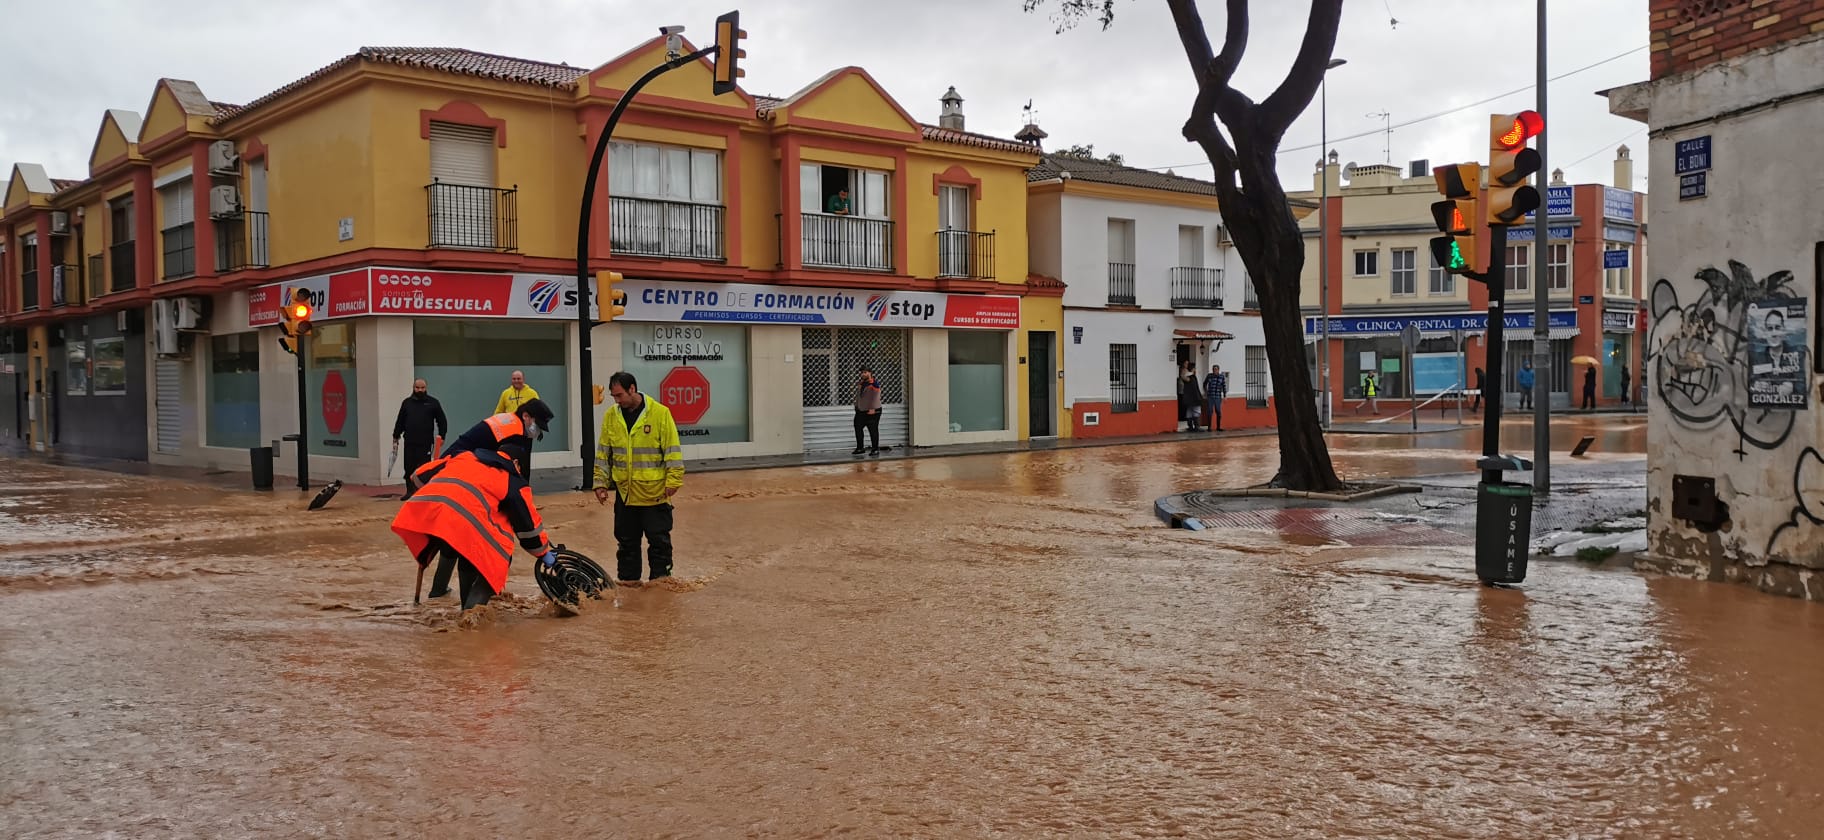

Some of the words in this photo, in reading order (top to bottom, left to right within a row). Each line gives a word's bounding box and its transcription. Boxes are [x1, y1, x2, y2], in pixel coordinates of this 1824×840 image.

[1682, 140, 1704, 152] CALLE
[1678, 158, 1686, 170] EL
[335, 298, 366, 312] FORMACIÓN
[380, 297, 493, 311] AUTOESCUELA
[642, 289, 719, 306] CENTRO
[726, 291, 748, 307] DE
[754, 291, 855, 310] FORMACIÓN
[890, 299, 935, 320] stop
[694, 311, 730, 319] PERMISOS
[736, 312, 763, 320] CURSOS
[769, 313, 815, 321] CERTIFICADOS
[953, 316, 975, 324] CURSOS
[980, 317, 1017, 325] CERTIFICADOS
[1356, 321, 1403, 331] CLINICA
[1409, 319, 1456, 330] DENTAL
[1461, 319, 1480, 329] DR.
[656, 328, 702, 338] CURSO
[639, 343, 721, 355] INTENSIVO
[668, 387, 702, 404] STOP
[1506, 503, 1518, 572] ÚSAME
